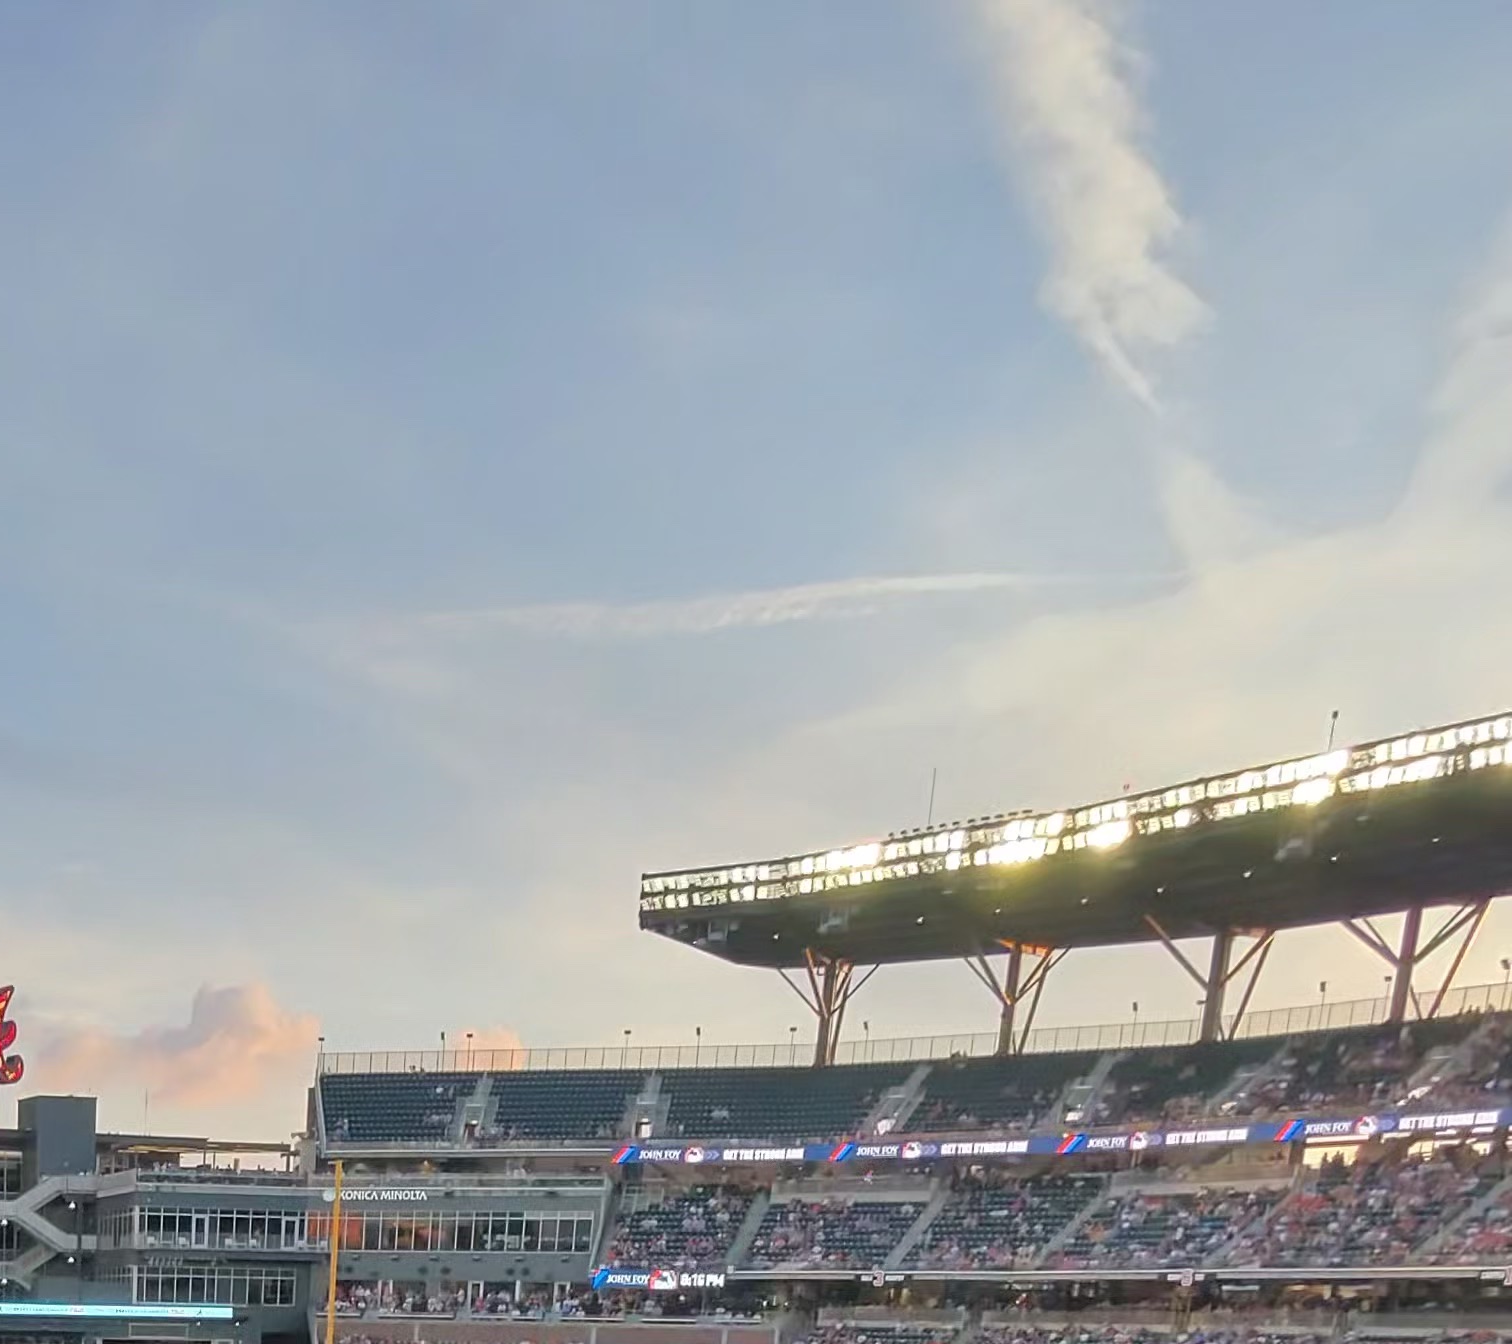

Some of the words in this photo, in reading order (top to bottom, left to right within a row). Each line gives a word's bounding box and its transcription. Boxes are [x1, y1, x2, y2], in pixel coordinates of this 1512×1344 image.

[638, 1150, 659, 1160] JOHN
[341, 1190, 378, 1200] KONICA
[380, 1190, 428, 1200] MINOLTA
[606, 1273, 629, 1284] JOHN
[705, 1273, 725, 1287] PM
